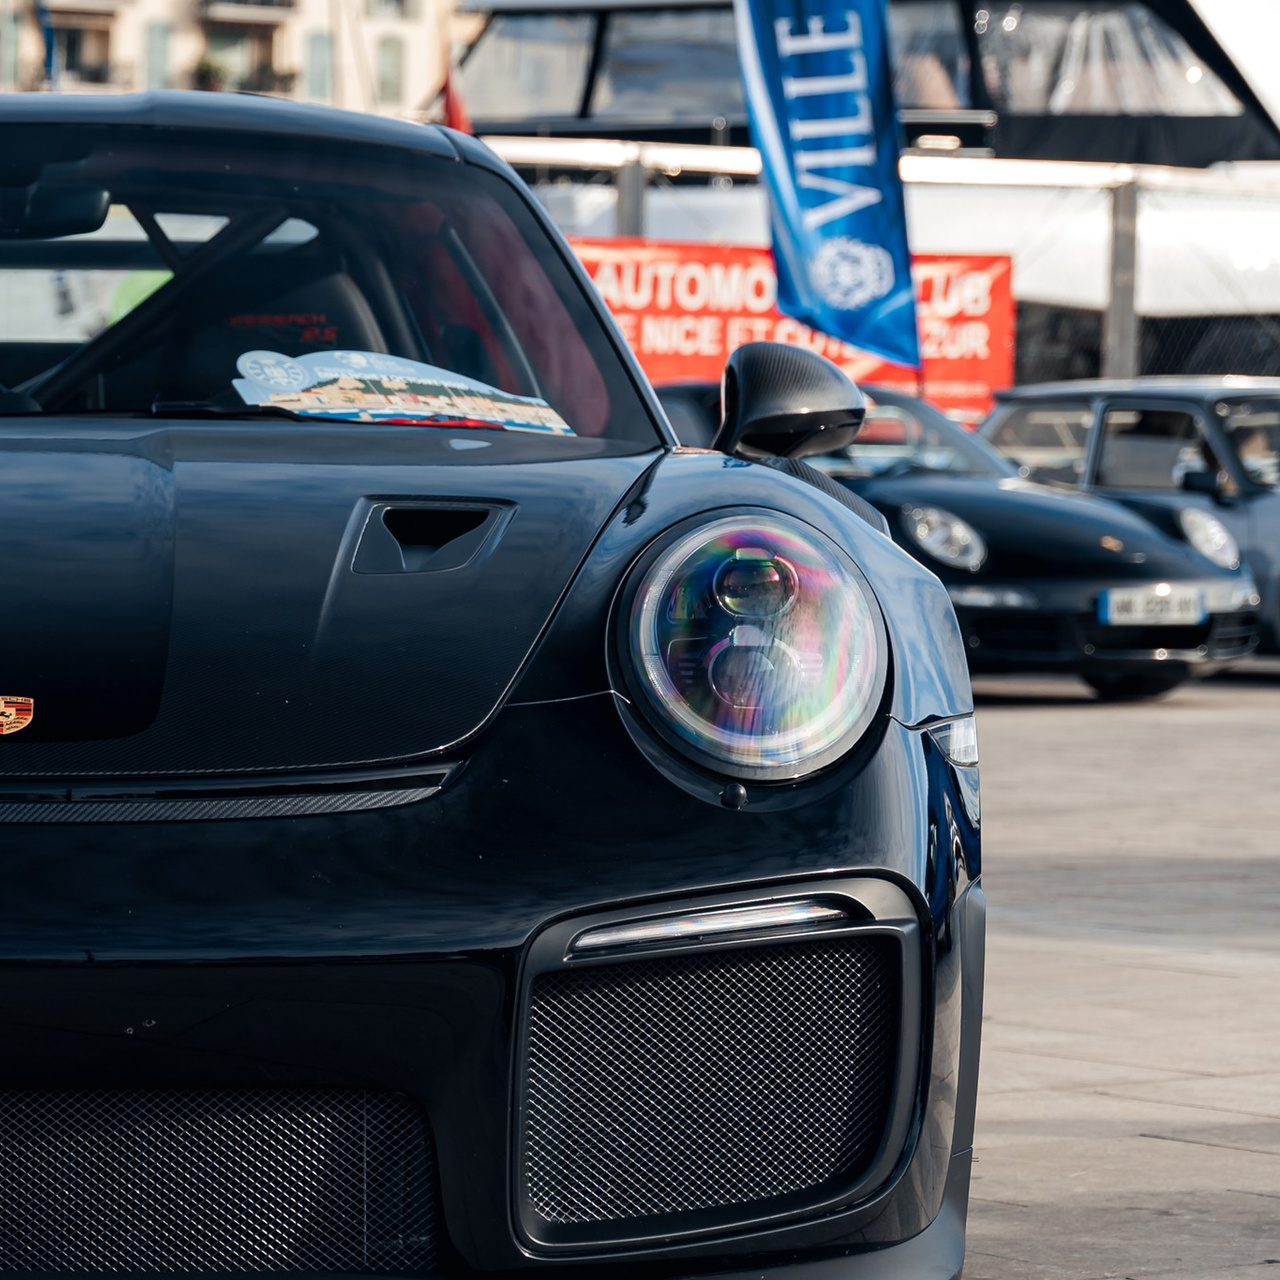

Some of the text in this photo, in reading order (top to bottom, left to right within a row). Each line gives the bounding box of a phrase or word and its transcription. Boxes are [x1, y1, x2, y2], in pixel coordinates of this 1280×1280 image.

[774, 9, 883, 230] VILLE
[595, 261, 991, 317] AUTOMO LUB
[641, 314, 723, 356] NICE
[921, 321, 991, 360] ZUR
